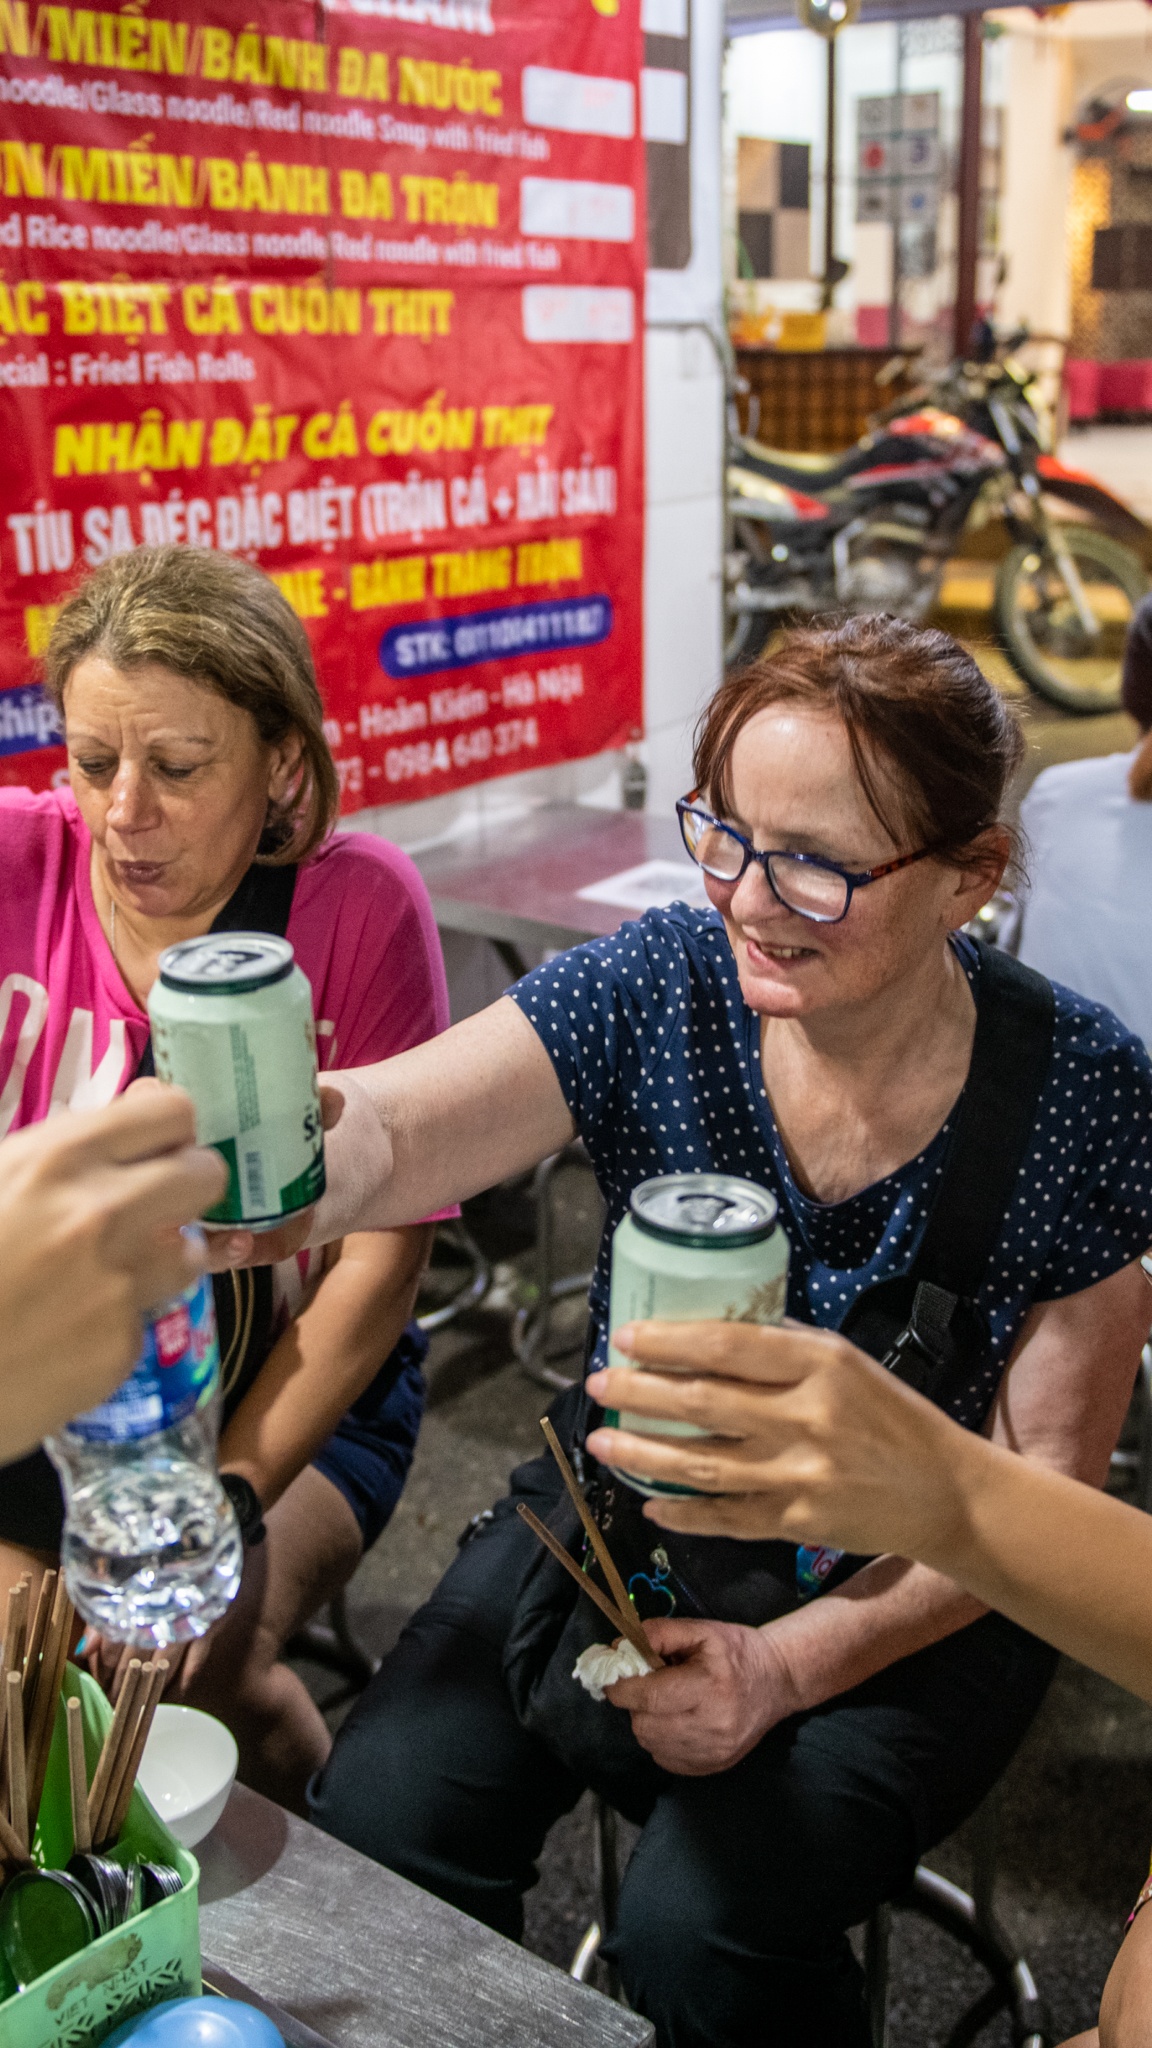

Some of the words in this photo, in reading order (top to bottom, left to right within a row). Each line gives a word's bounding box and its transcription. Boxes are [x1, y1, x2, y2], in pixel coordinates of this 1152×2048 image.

[302, 108, 376, 142] noodle
[377, 112, 428, 152] Soup
[432, 121, 470, 151] with
[26, 214, 90, 249] Rice
[375, 236, 440, 266] noodle
[443, 238, 477, 267] with
[59, 272, 170, 346] BIỆT
[182, 274, 243, 336] CÁ
[367, 287, 455, 344] THỊT
[71, 351, 141, 386] Fried
[144, 351, 195, 384] Fish
[197, 351, 255, 382] Rolls
[54, 408, 203, 487] NHẬN
[210, 403, 299, 477] ĐẶT
[302, 399, 358, 458] CÁ
[366, 388, 476, 457] CUỐN
[482, 403, 554, 457] THỊT
[7, 498, 73, 576] TÍU
[287, 475, 356, 552] BIỆT
[450, 465, 489, 527] CÁ
[359, 696, 428, 740] Hoàn
[430, 682, 489, 725] Kiếm
[502, 671, 536, 708] Hà
[537, 662, 584, 704] Nội
